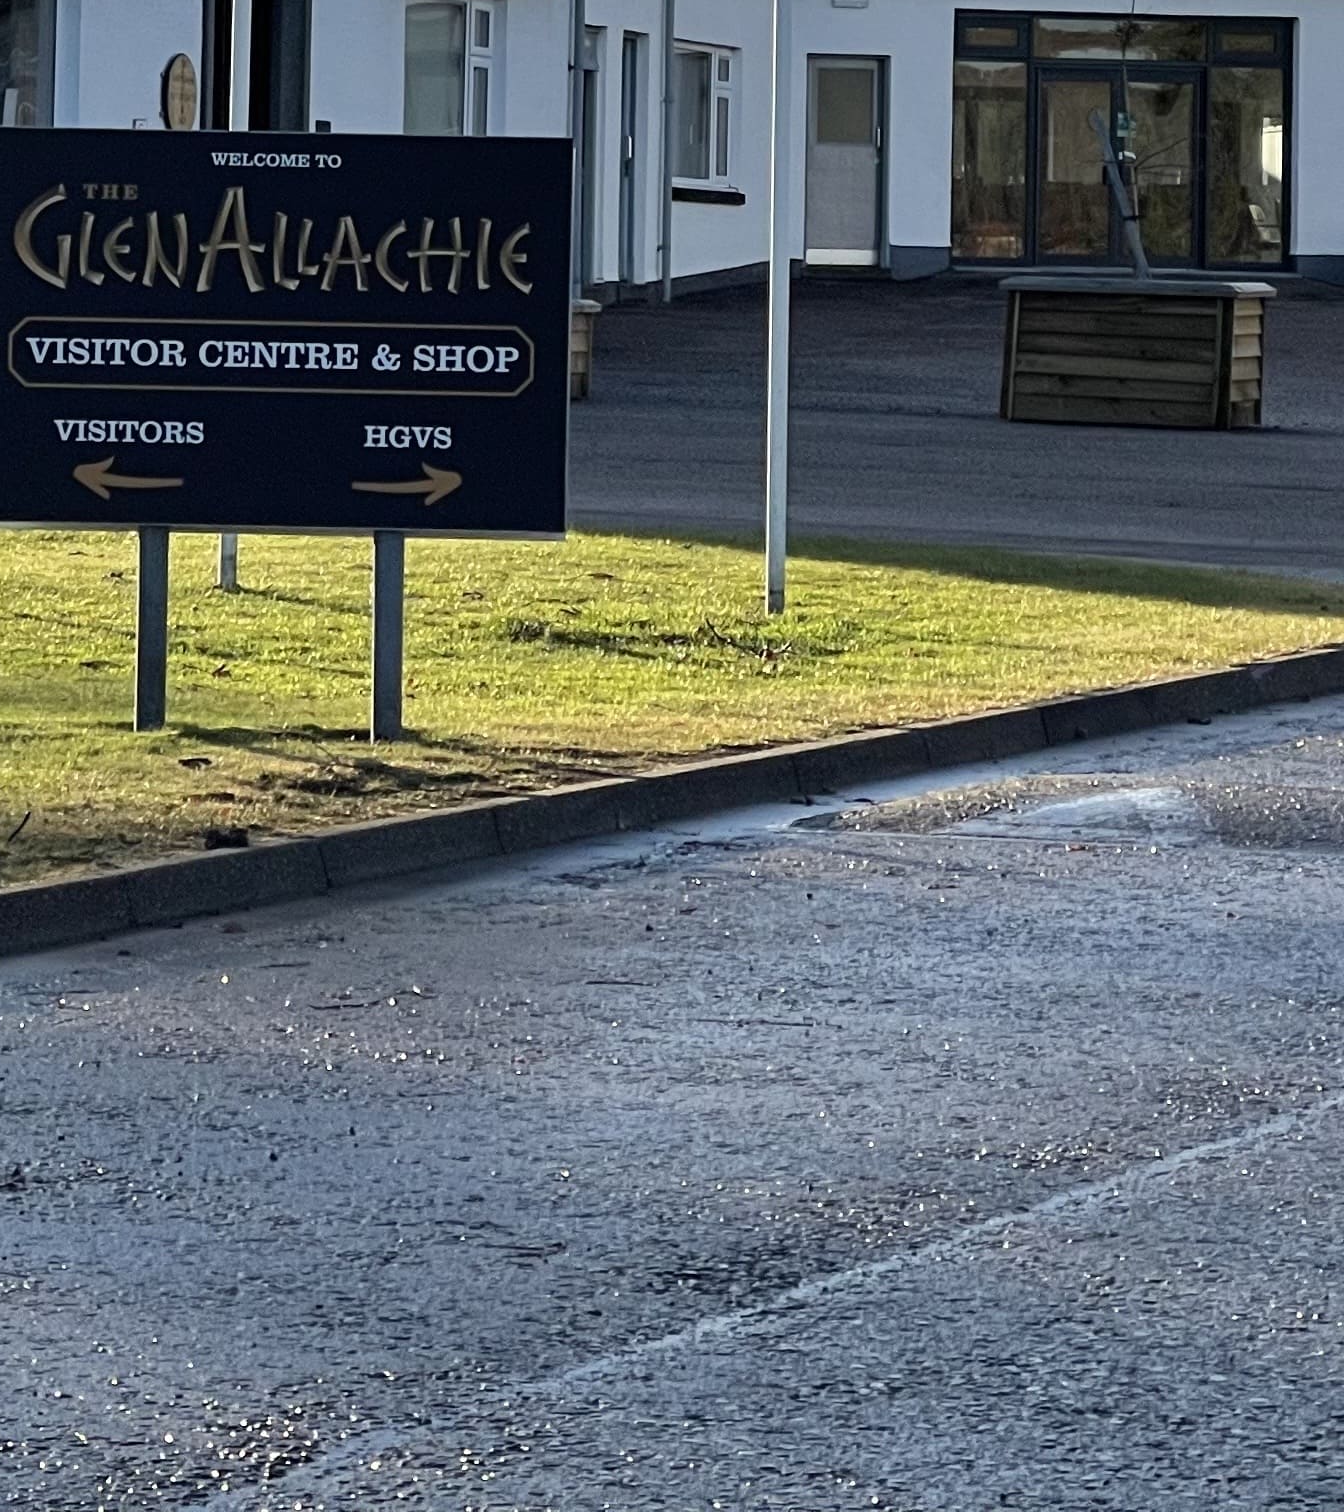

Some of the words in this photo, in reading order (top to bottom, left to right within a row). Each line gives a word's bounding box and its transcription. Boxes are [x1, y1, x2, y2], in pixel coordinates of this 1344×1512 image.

[210, 151, 311, 168] WELCOME
[314, 153, 343, 169] TO
[82, 183, 139, 201] THE
[24, 337, 188, 368] VISITOR
[197, 339, 360, 371] CENTRE
[370, 343, 402, 373] &
[411, 344, 521, 374] SHOP
[52, 418, 206, 446] VISITORS
[362, 424, 453, 451] HGVS
